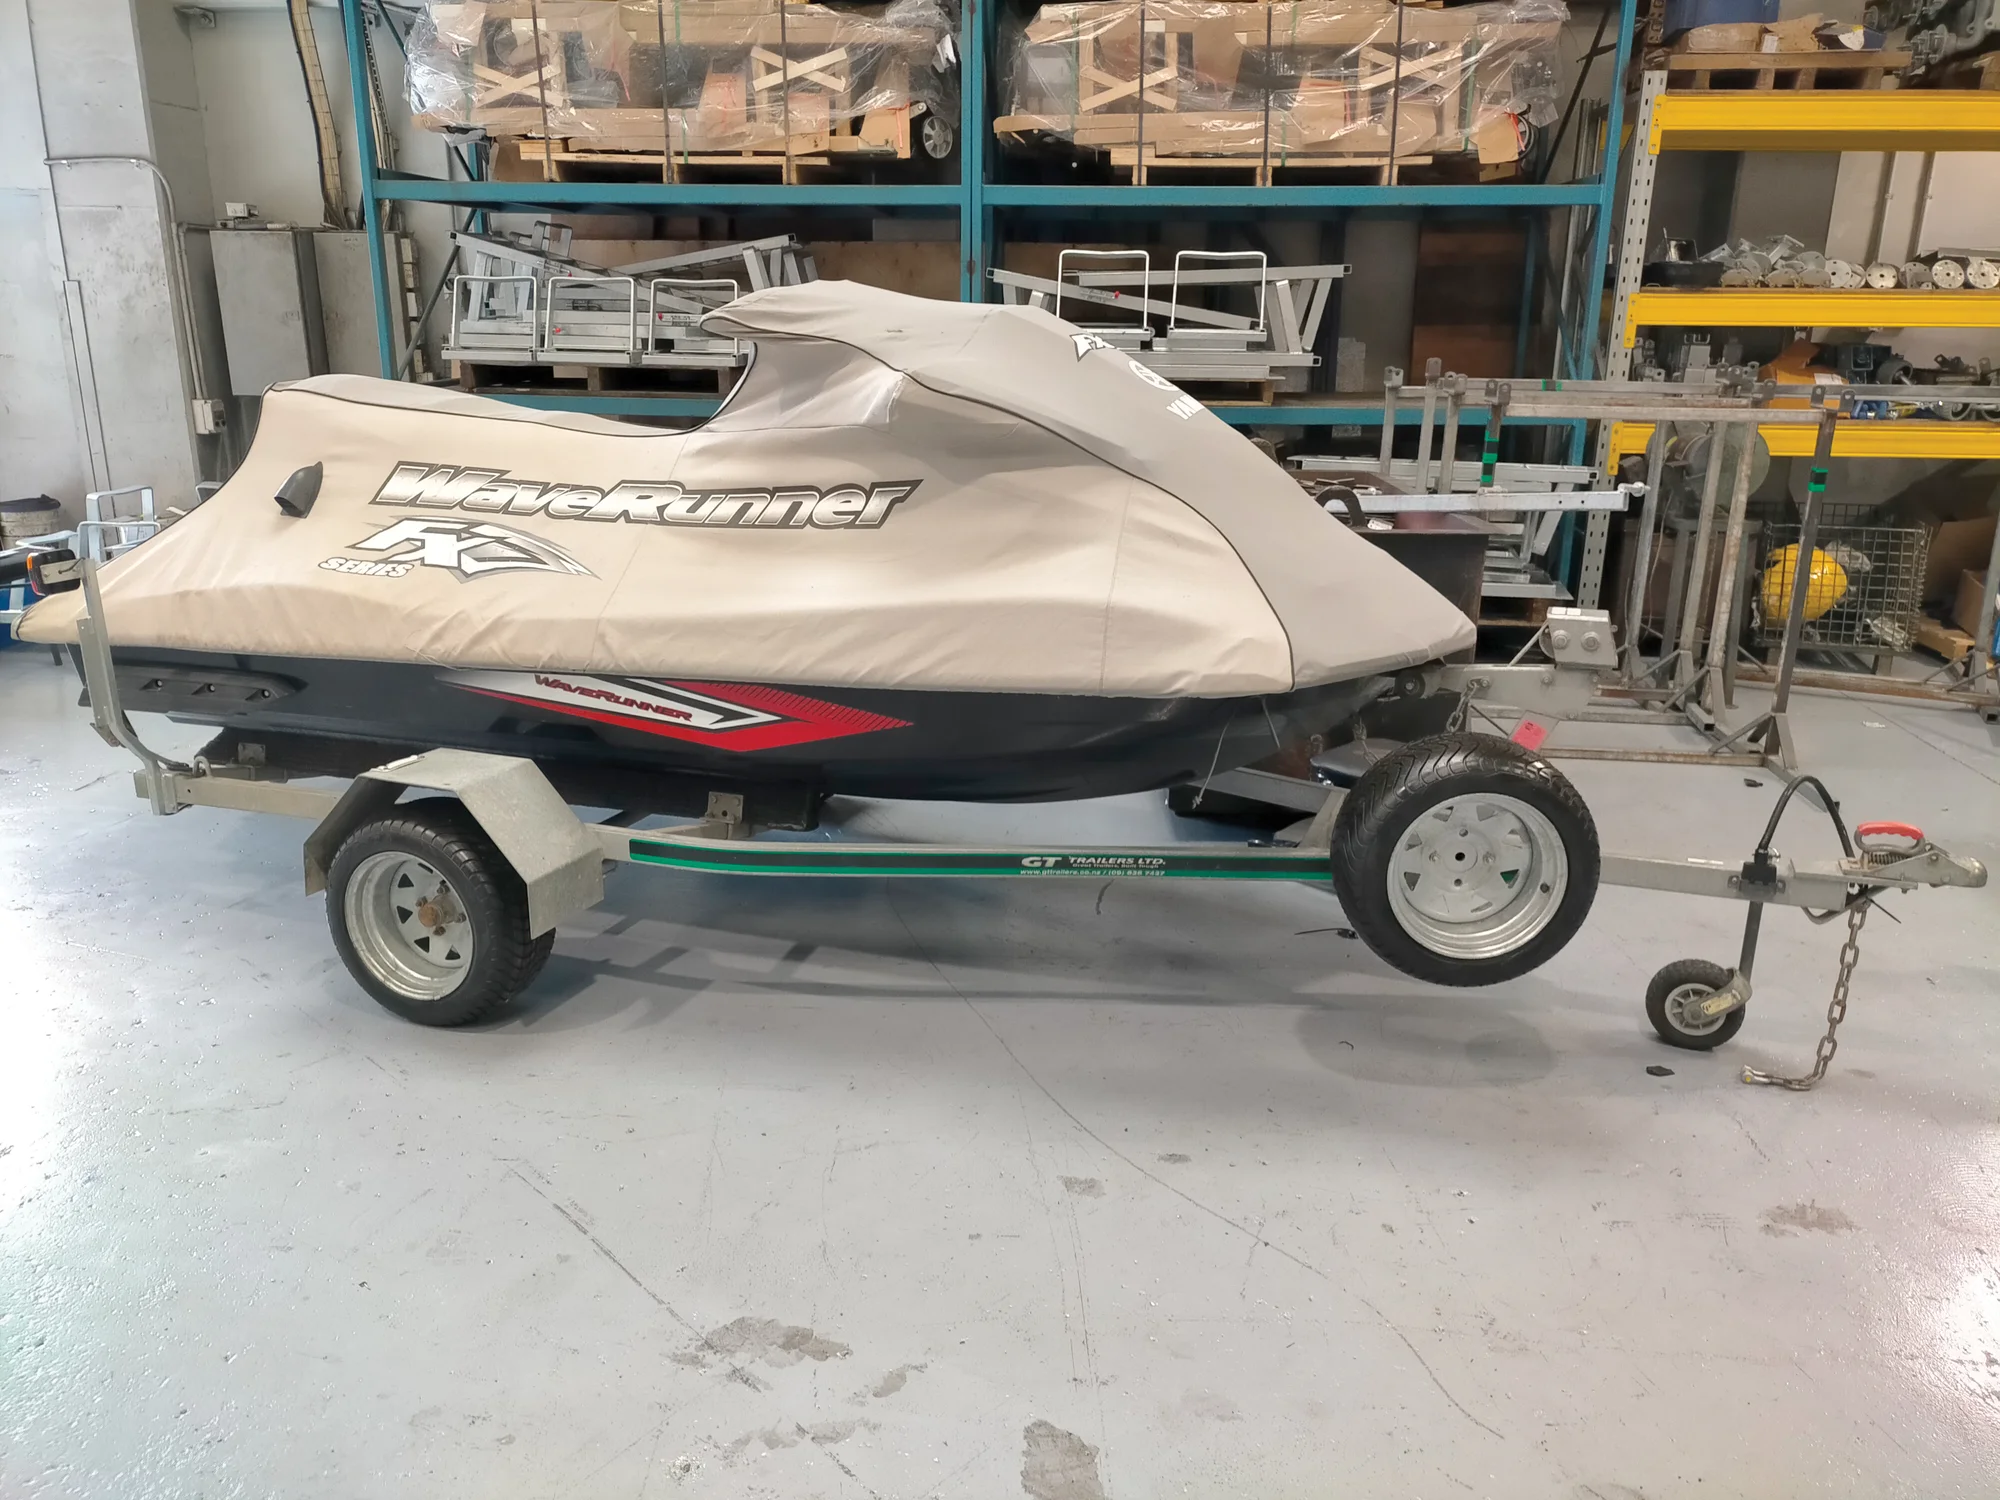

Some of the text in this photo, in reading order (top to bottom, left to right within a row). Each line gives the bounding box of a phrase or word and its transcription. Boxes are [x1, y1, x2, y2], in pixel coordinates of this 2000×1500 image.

[368, 461, 924, 529] WaveRunner
[318, 556, 415, 578] SERIES
[534, 674, 693, 722] WAVERUNNER
[1021, 856, 1166, 867] GT TRAILERS LTD.
